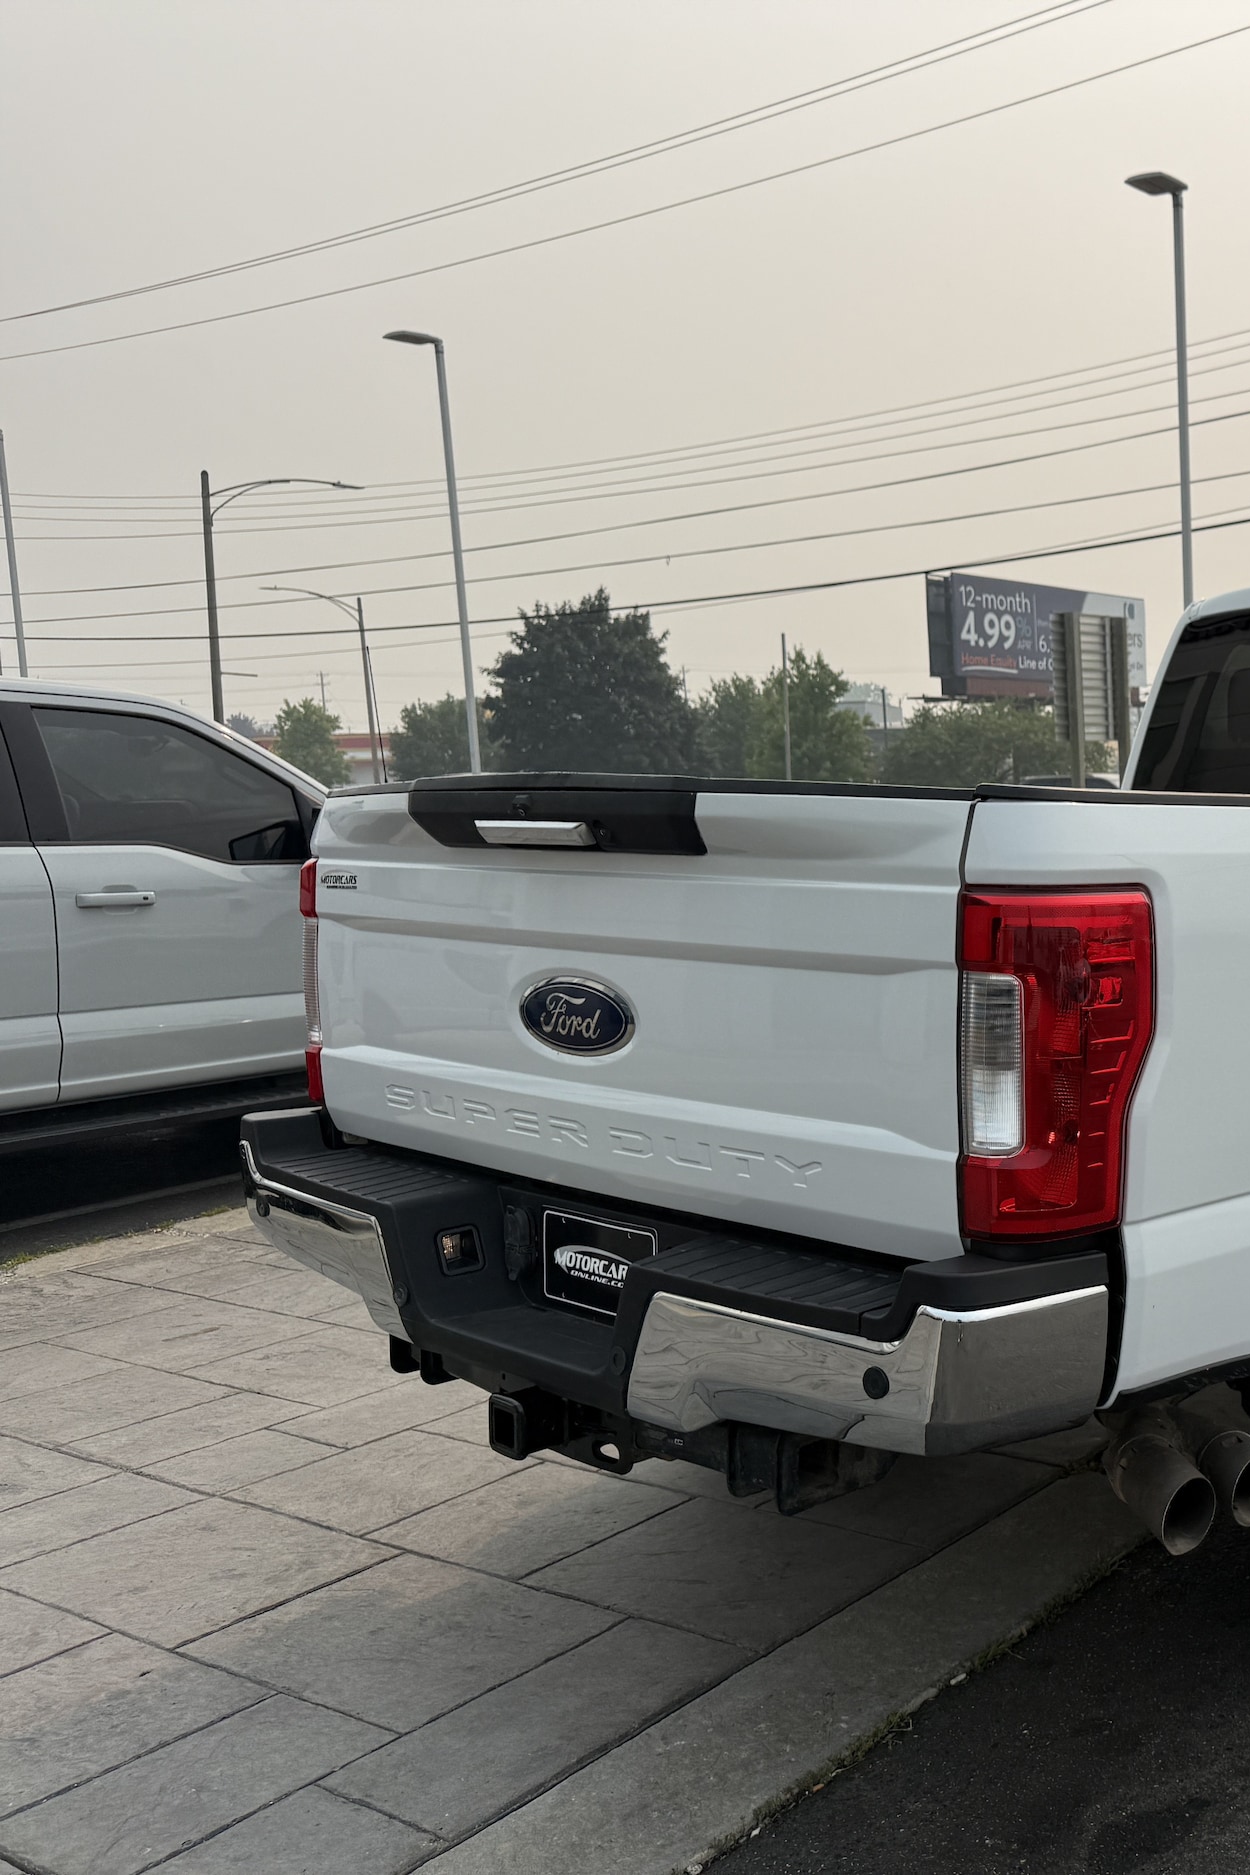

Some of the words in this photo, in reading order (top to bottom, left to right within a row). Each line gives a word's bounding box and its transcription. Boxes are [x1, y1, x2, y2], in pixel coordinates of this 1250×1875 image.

[959, 584, 1031, 614] 12-month
[961, 652, 988, 666] Home
[990, 654, 1018, 669] Equity
[1018, 656, 1036, 669] Line
[1038, 657, 1047, 670] of
[320, 874, 358, 885] MOTORCARS
[541, 992, 601, 1040] Ford
[384, 1083, 588, 1148] SUPER
[608, 1126, 823, 1189] DUTY
[554, 1248, 629, 1281] MOTORCAR
[570, 1269, 625, 1289] ONLINE.CO
